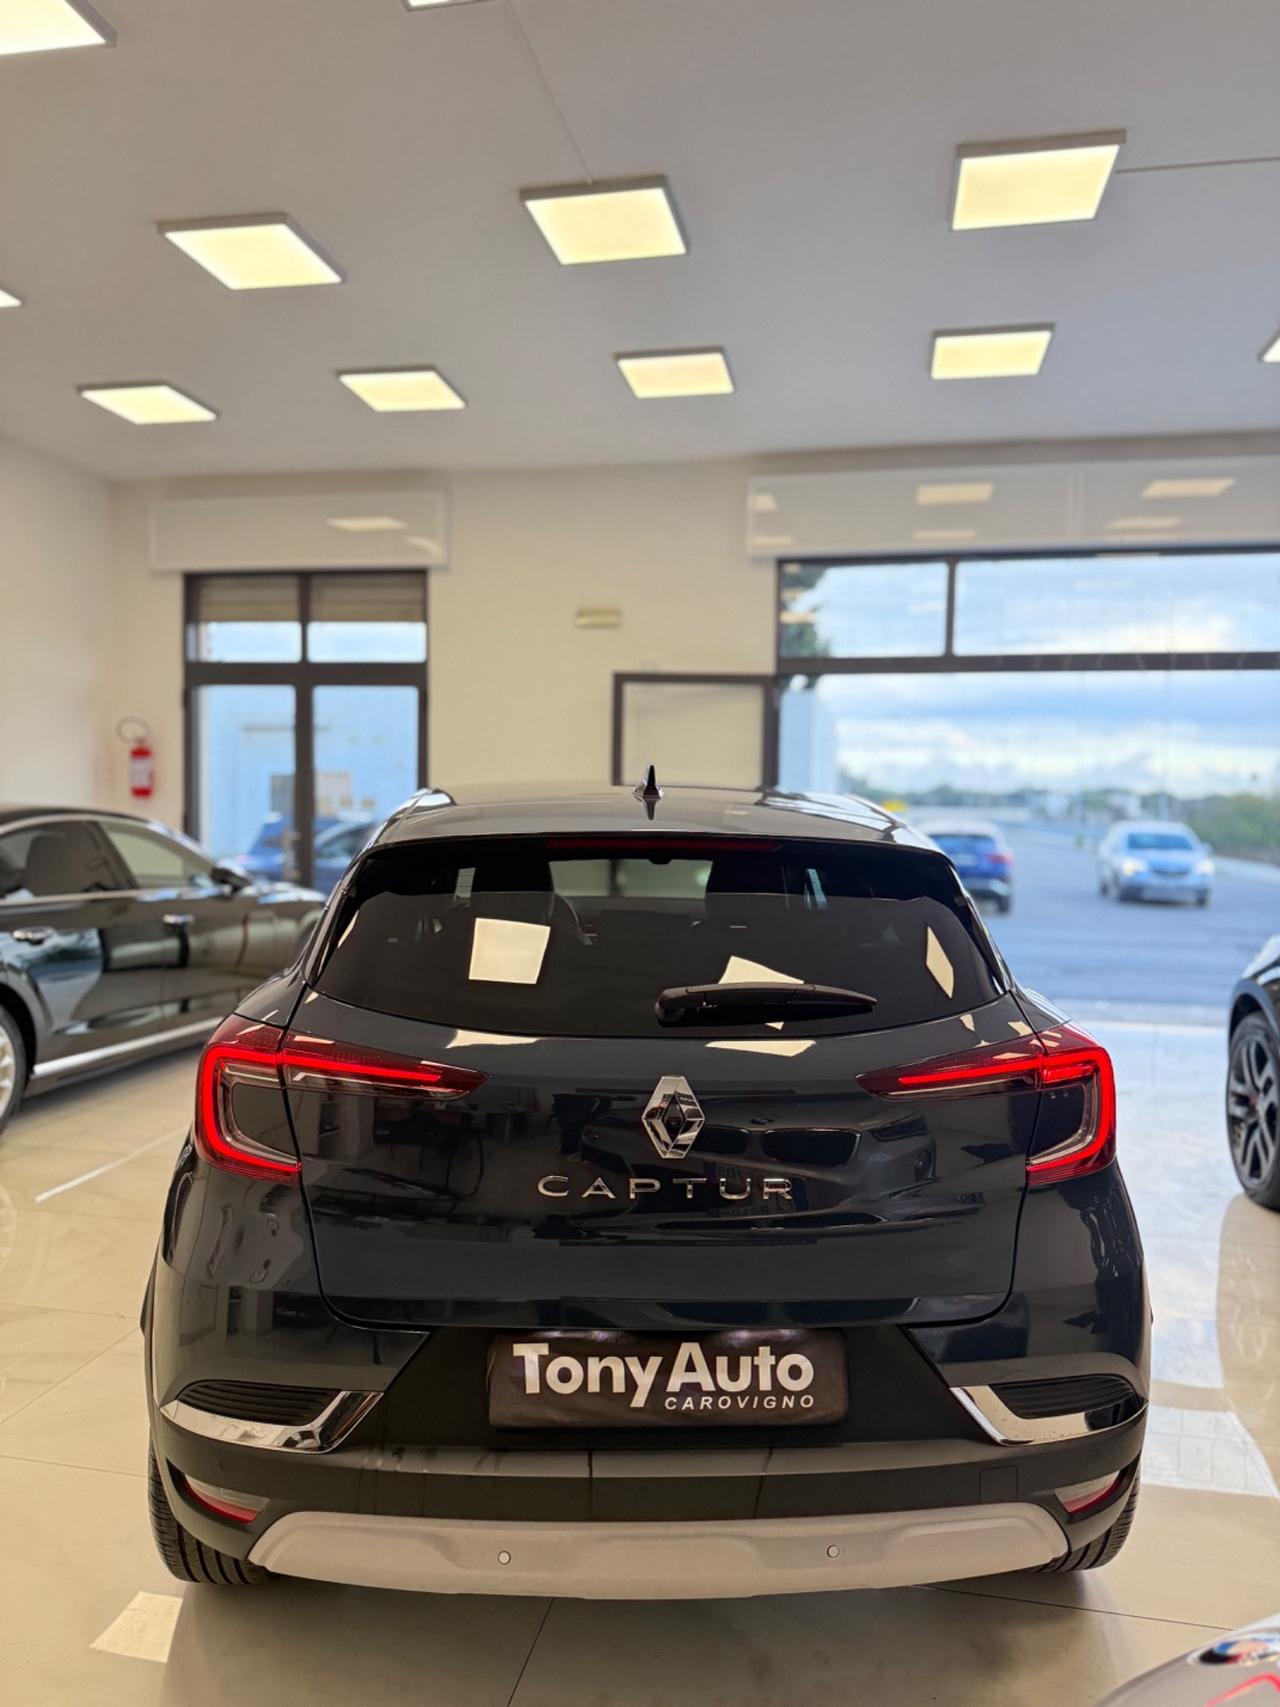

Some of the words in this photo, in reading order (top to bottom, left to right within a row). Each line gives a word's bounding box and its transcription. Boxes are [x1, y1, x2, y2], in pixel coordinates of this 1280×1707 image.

[537, 1175, 793, 1200] CAPTUR
[512, 1342, 663, 1408] Tony
[665, 1342, 815, 1393] Auto
[664, 1394, 815, 1411] CAROVIGNO
